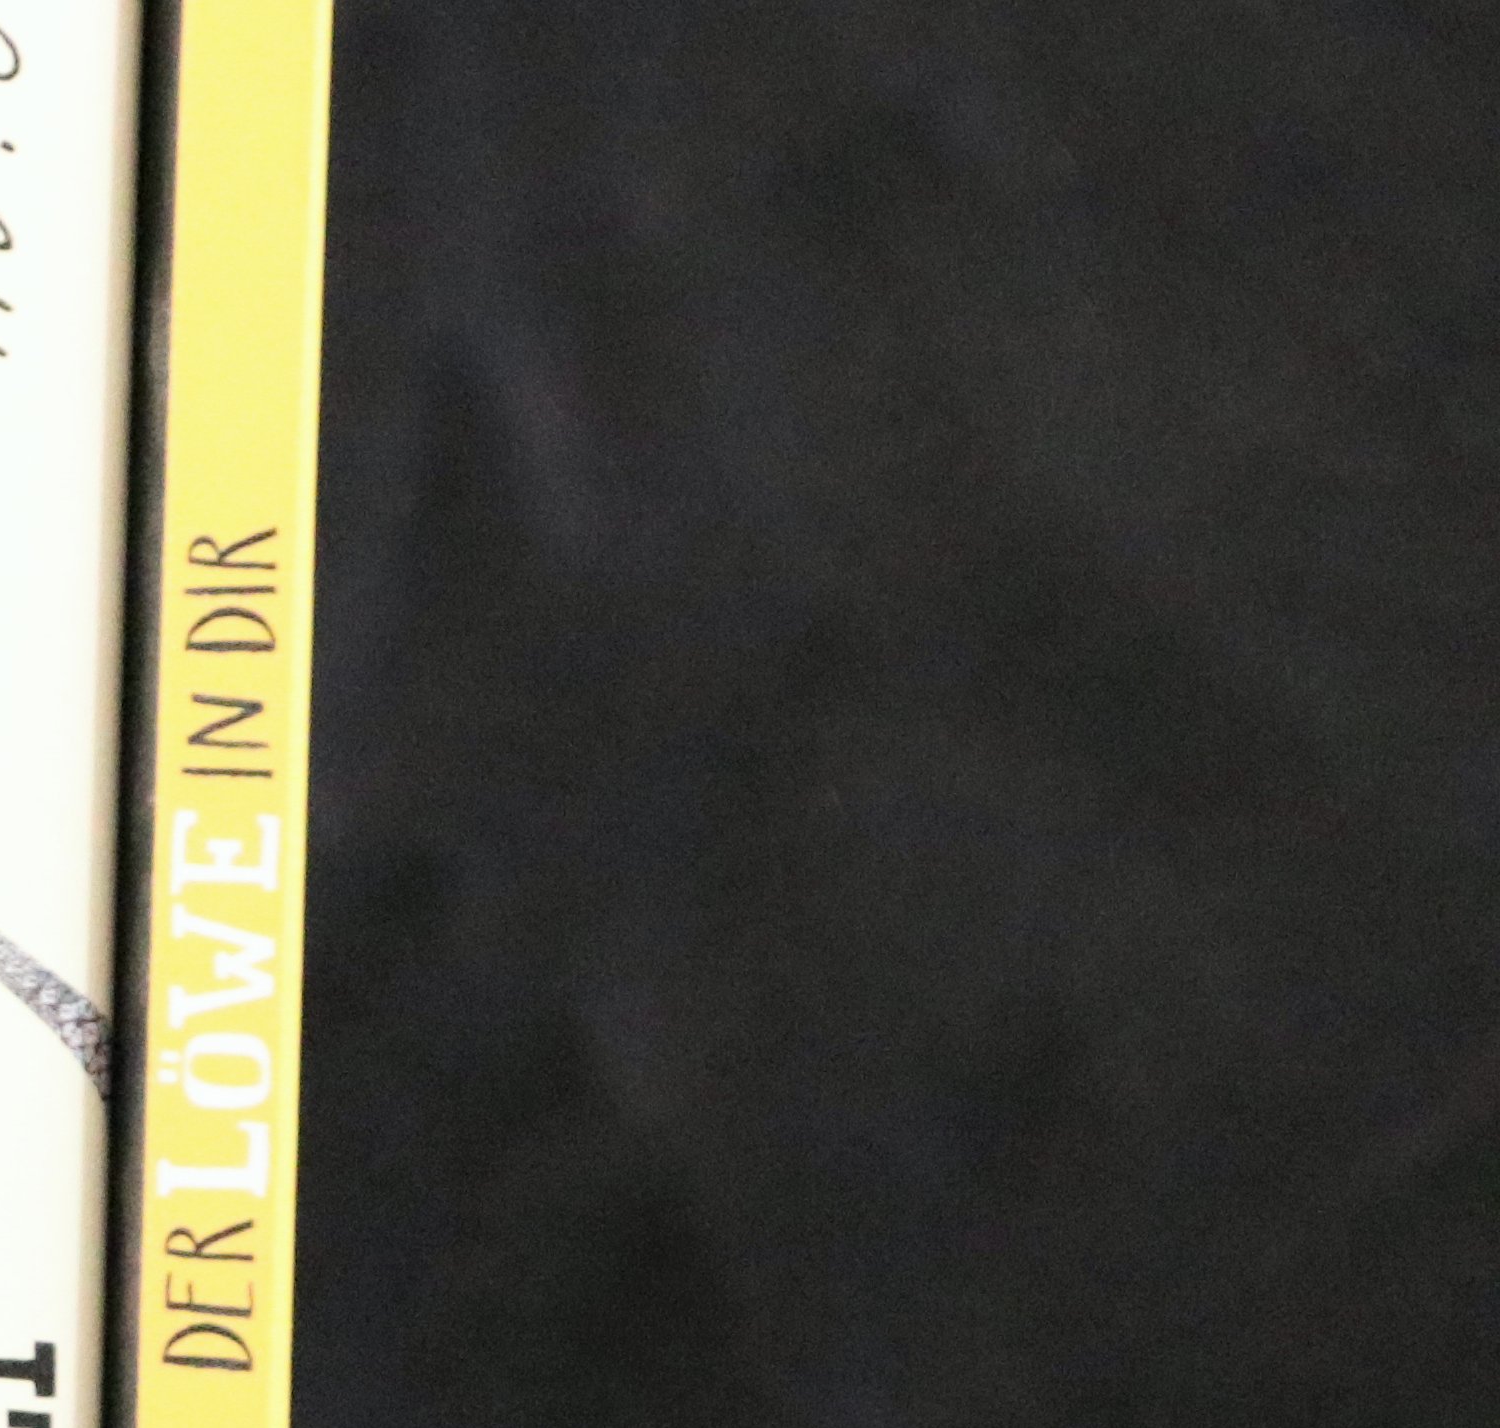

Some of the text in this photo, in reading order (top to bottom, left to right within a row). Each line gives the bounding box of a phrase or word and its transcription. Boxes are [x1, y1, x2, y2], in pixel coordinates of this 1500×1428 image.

[156, 526, 281, 1373] DER LÖWE IN DIR
